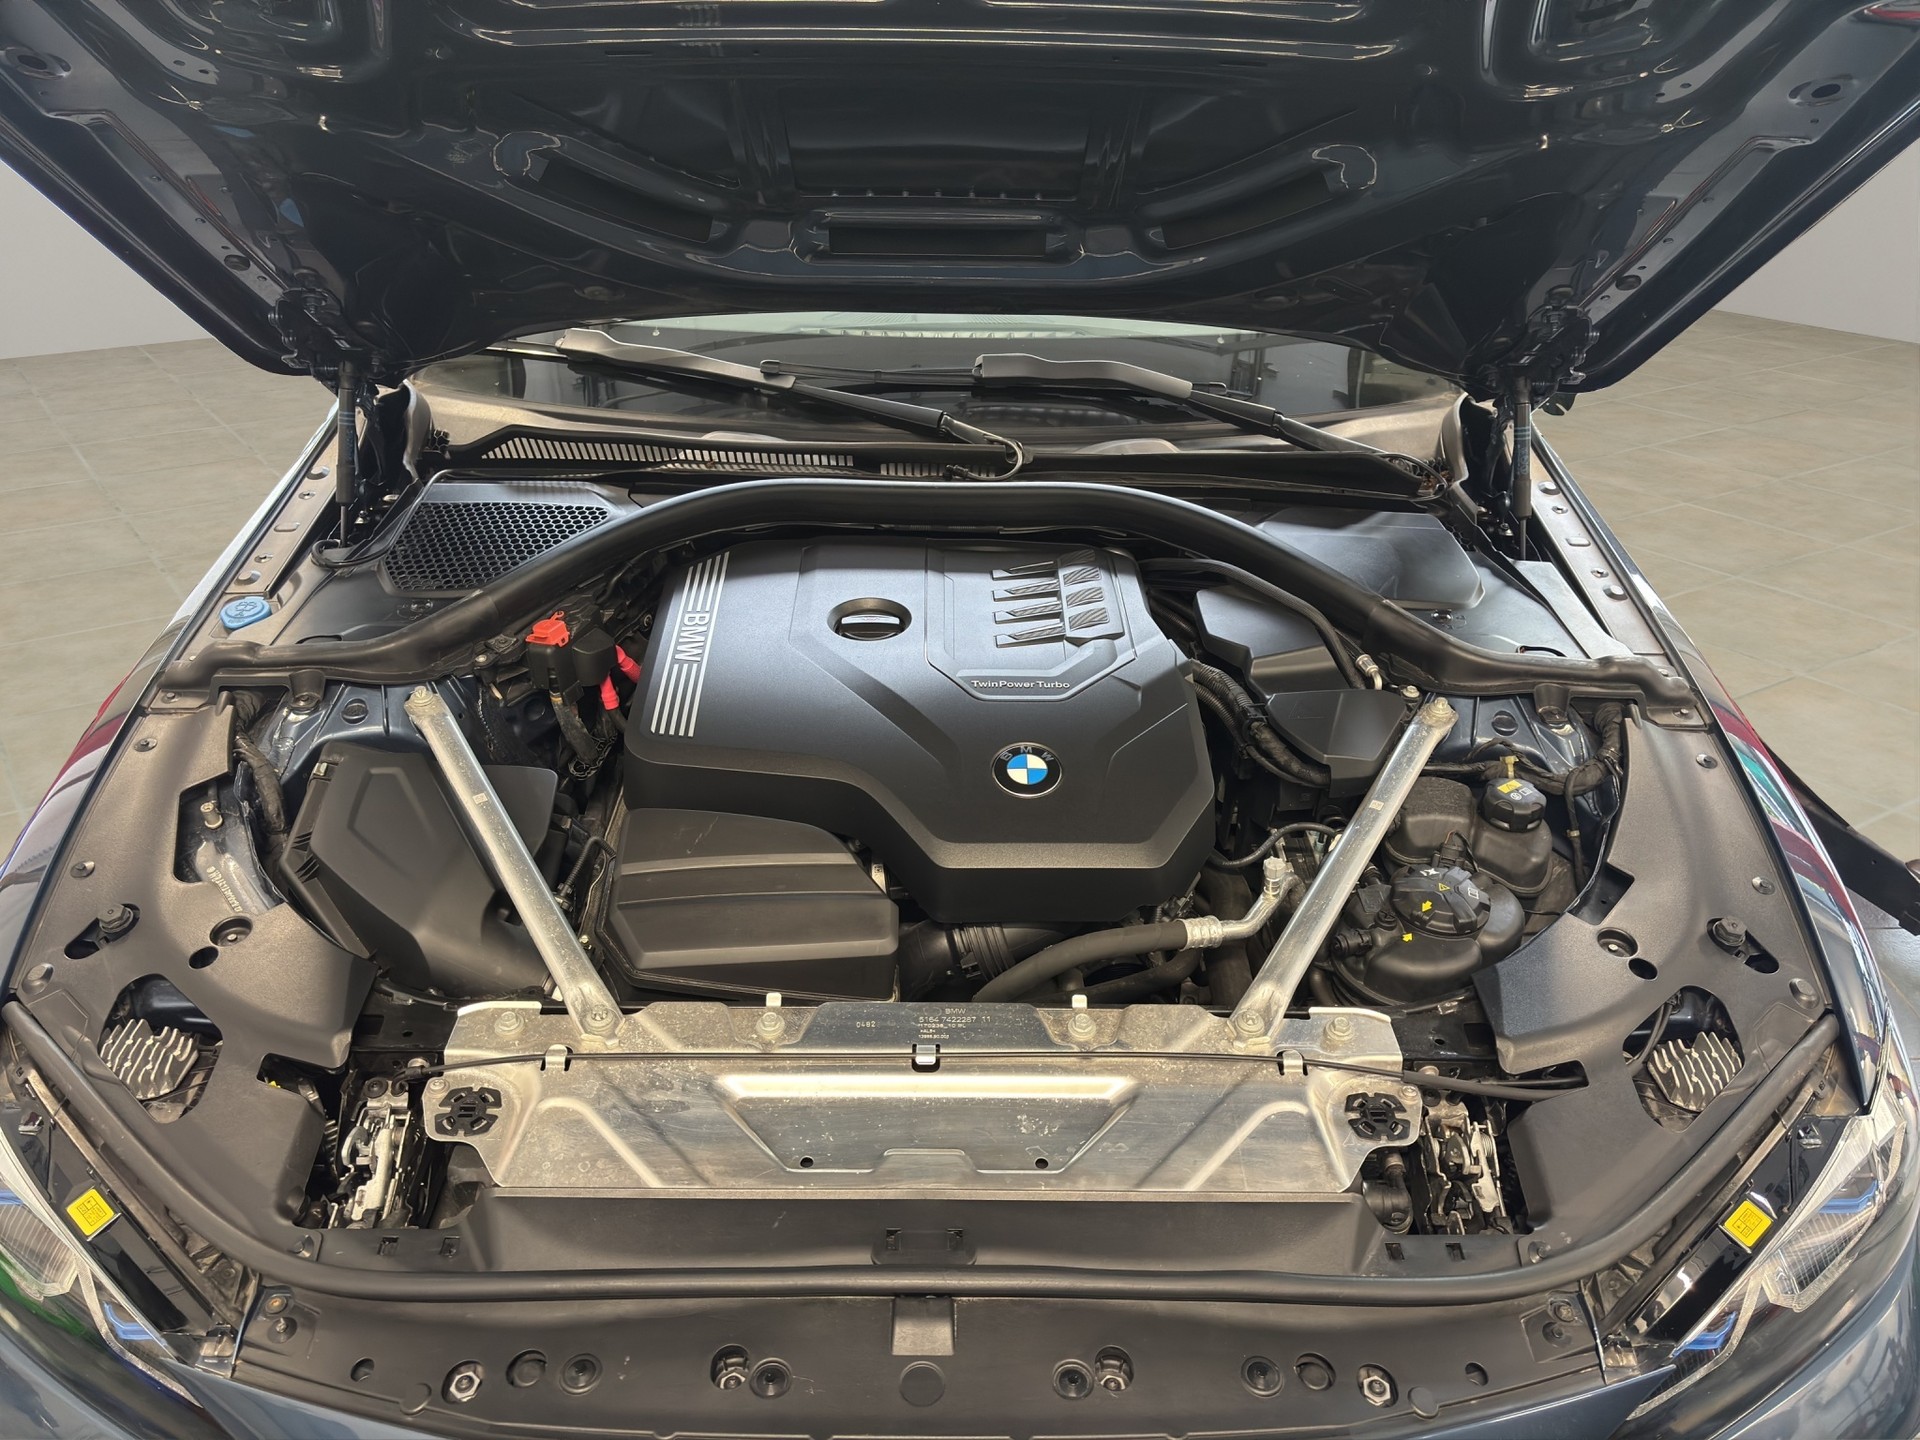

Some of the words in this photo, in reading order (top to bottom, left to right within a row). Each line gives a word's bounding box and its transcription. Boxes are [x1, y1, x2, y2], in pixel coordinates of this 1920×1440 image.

[674, 612, 711, 662] BMW
[971, 680, 1035, 689] TwinPower
[1036, 680, 1071, 689] Turbo
[1000, 746, 1055, 762] BMW
